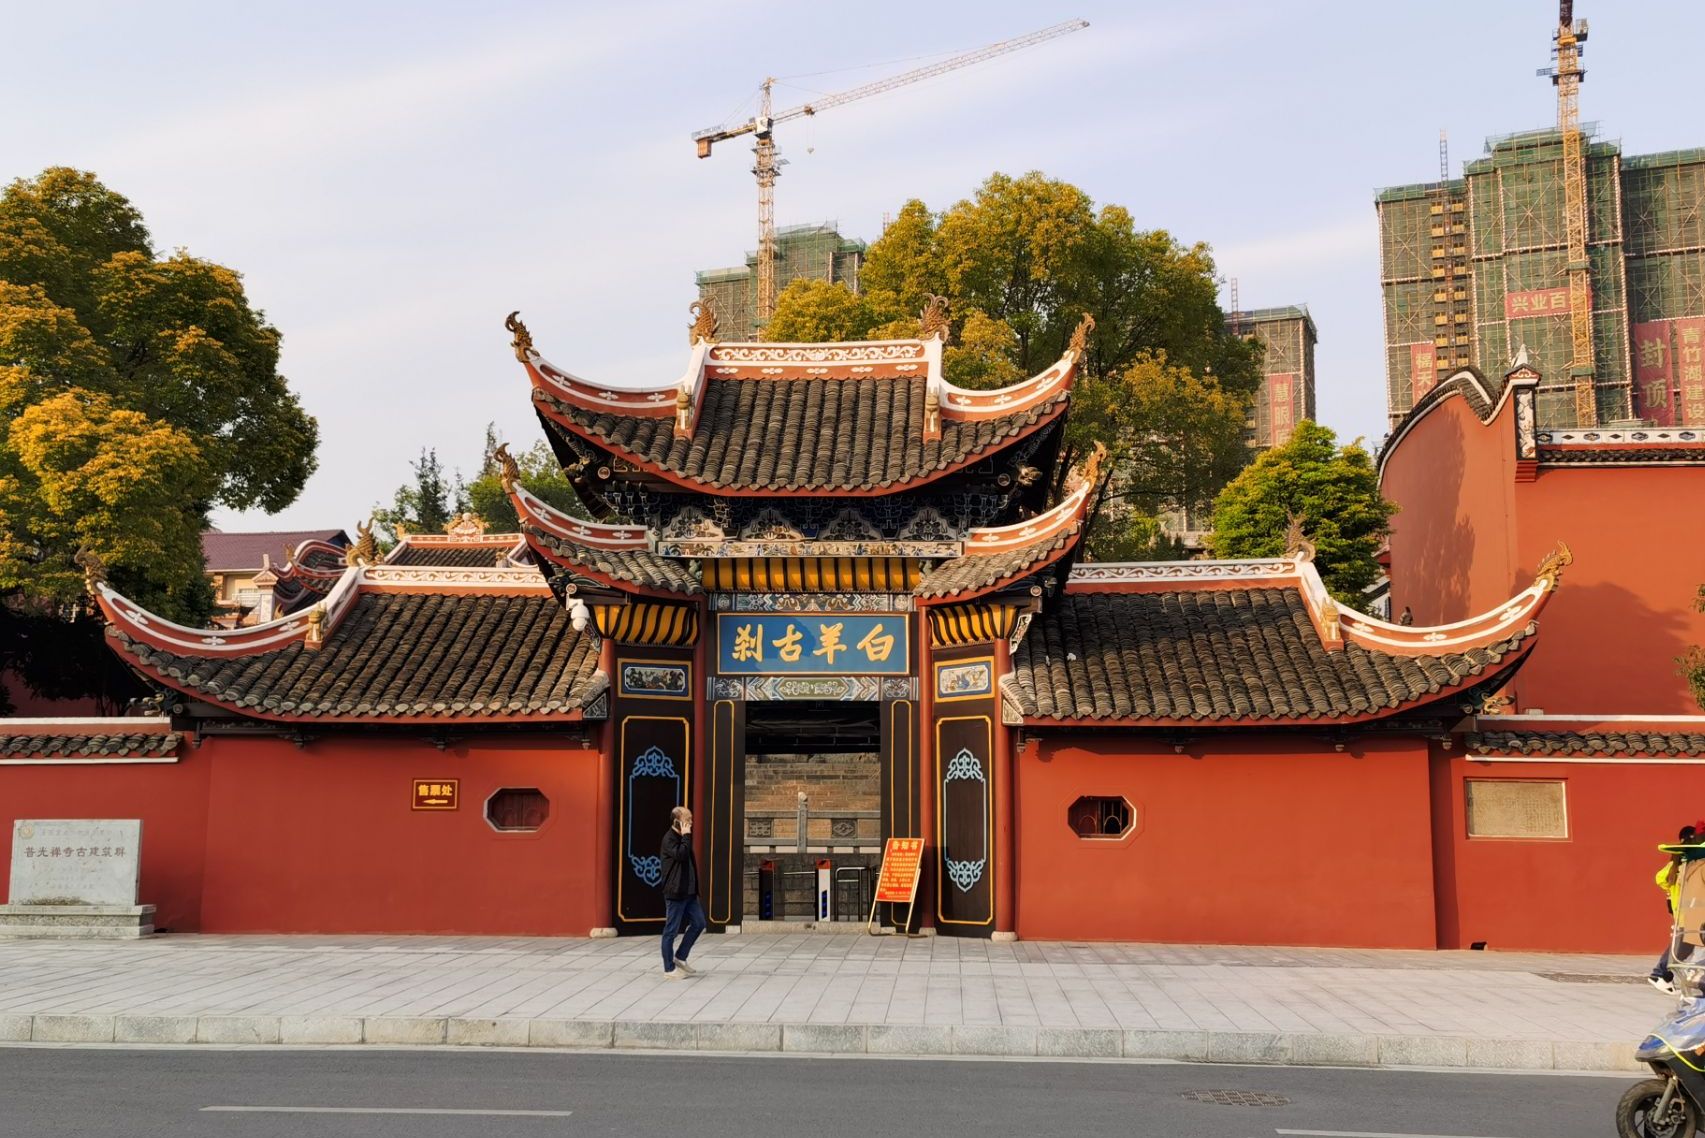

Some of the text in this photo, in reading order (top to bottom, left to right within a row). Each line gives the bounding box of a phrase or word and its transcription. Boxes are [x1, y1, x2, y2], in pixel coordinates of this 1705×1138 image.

[1511, 291, 1570, 313] 兴业百
[1415, 352, 1433, 396] 福天
[1640, 337, 1668, 426] 封顶
[1681, 327, 1705, 424] 青竹湖建设
[731, 622, 895, 664] 白羊古刹
[418, 784, 453, 796] 售票处
